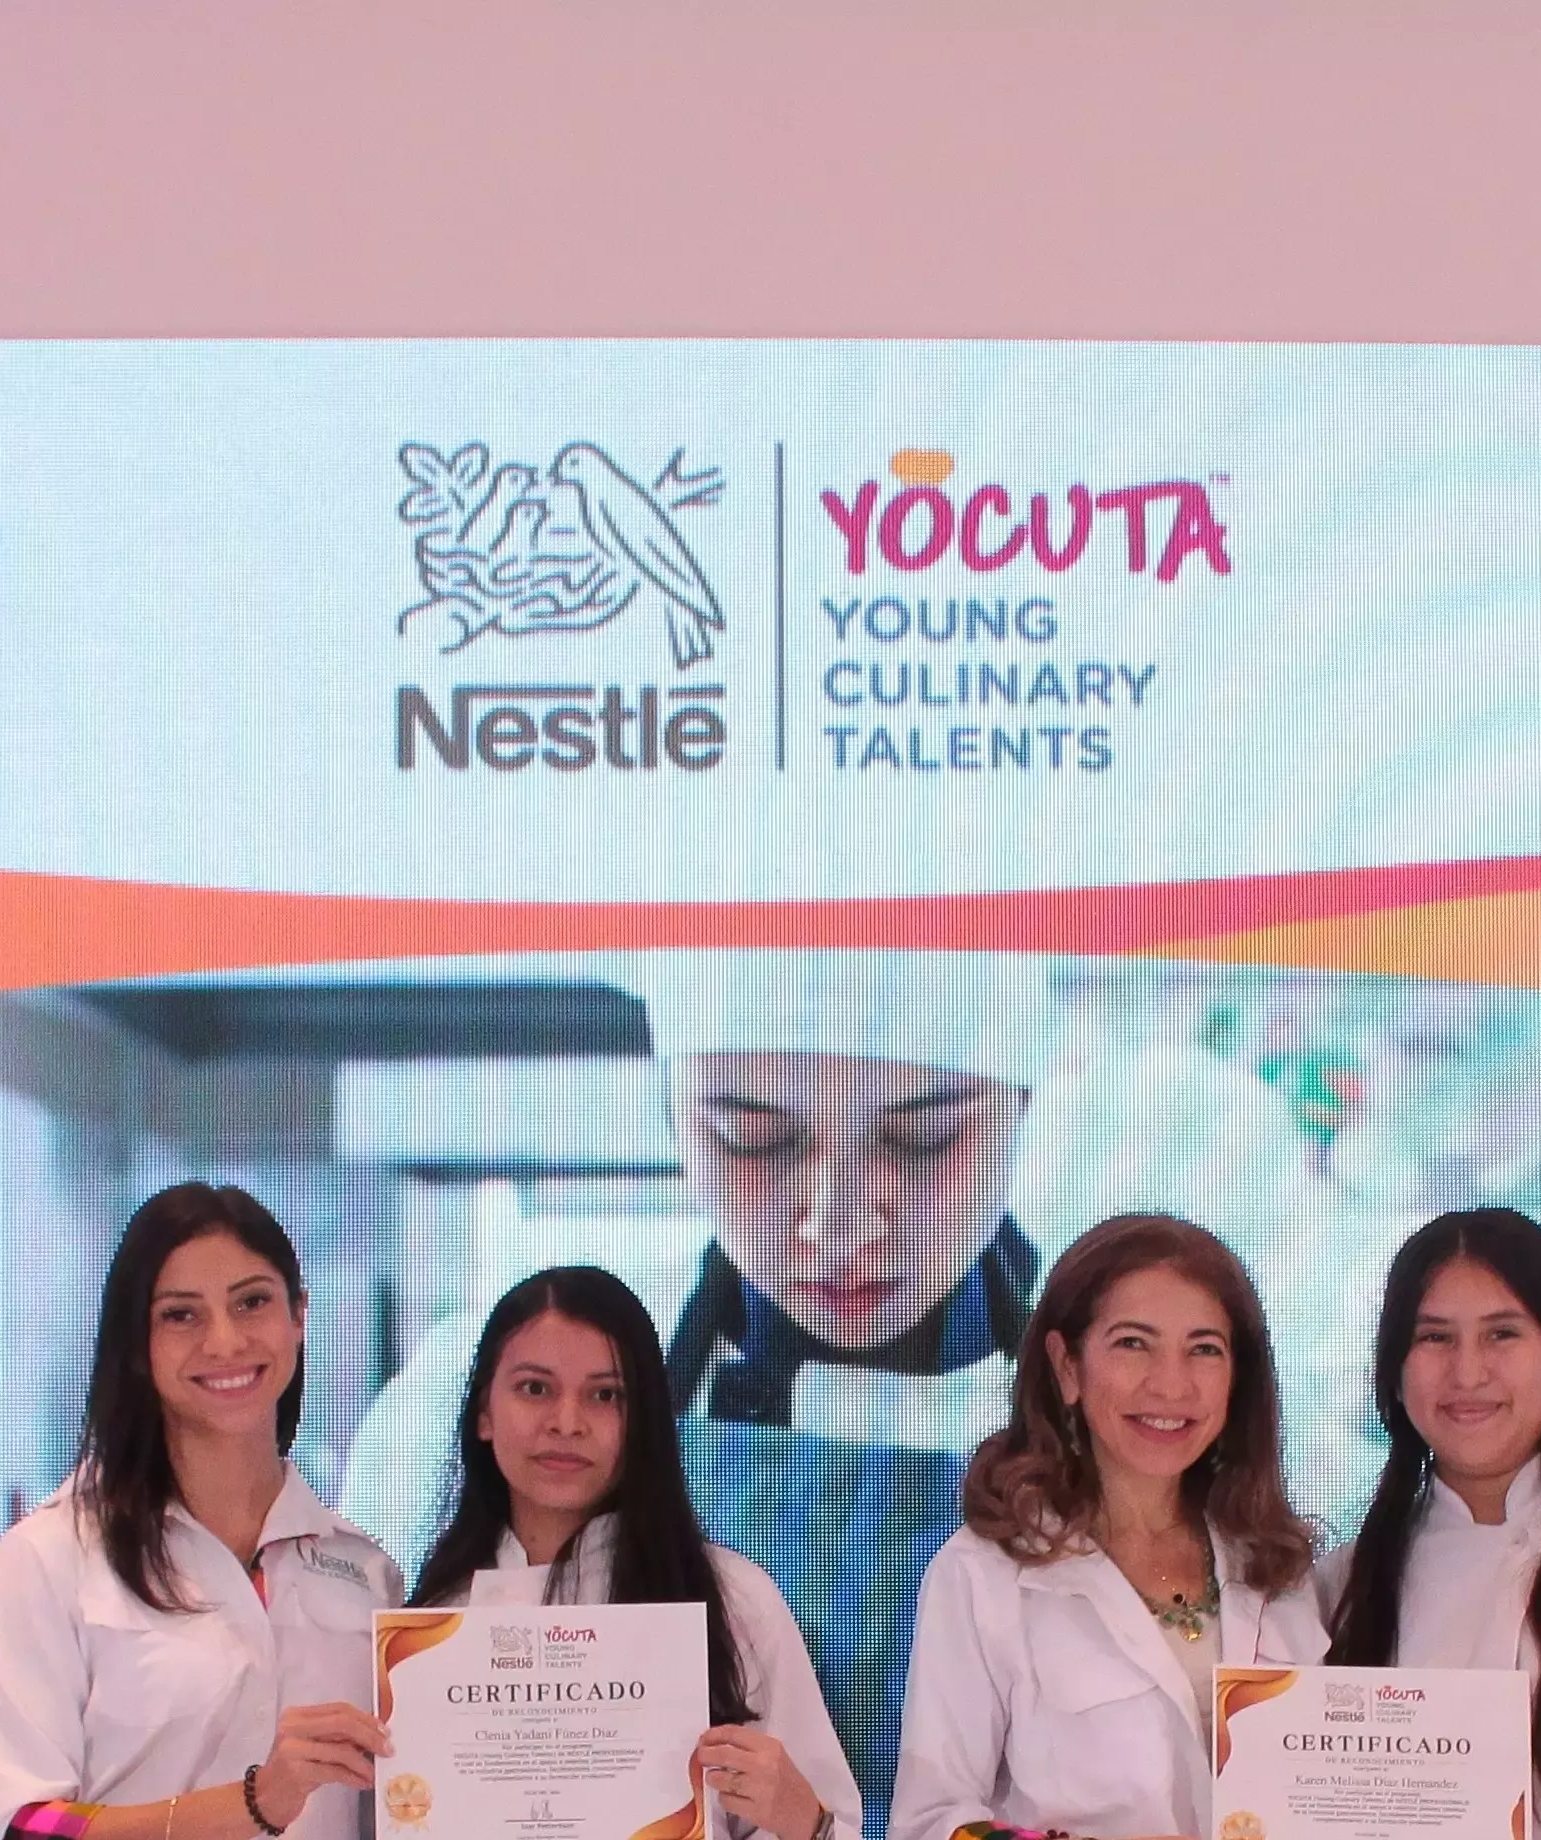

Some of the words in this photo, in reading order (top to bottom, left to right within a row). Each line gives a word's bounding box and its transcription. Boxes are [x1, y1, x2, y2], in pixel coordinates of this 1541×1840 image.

[821, 597, 1059, 643] YOUNG
[821, 662, 1157, 708] CULINARY
[396, 684, 726, 771] Nestlé
[821, 726, 1114, 772] TALENTS
[447, 1681, 645, 1703] CERTIFICADO
[1283, 1734, 1471, 1754] CERTIFICADO
[1294, 1775, 1327, 1786] Karen
